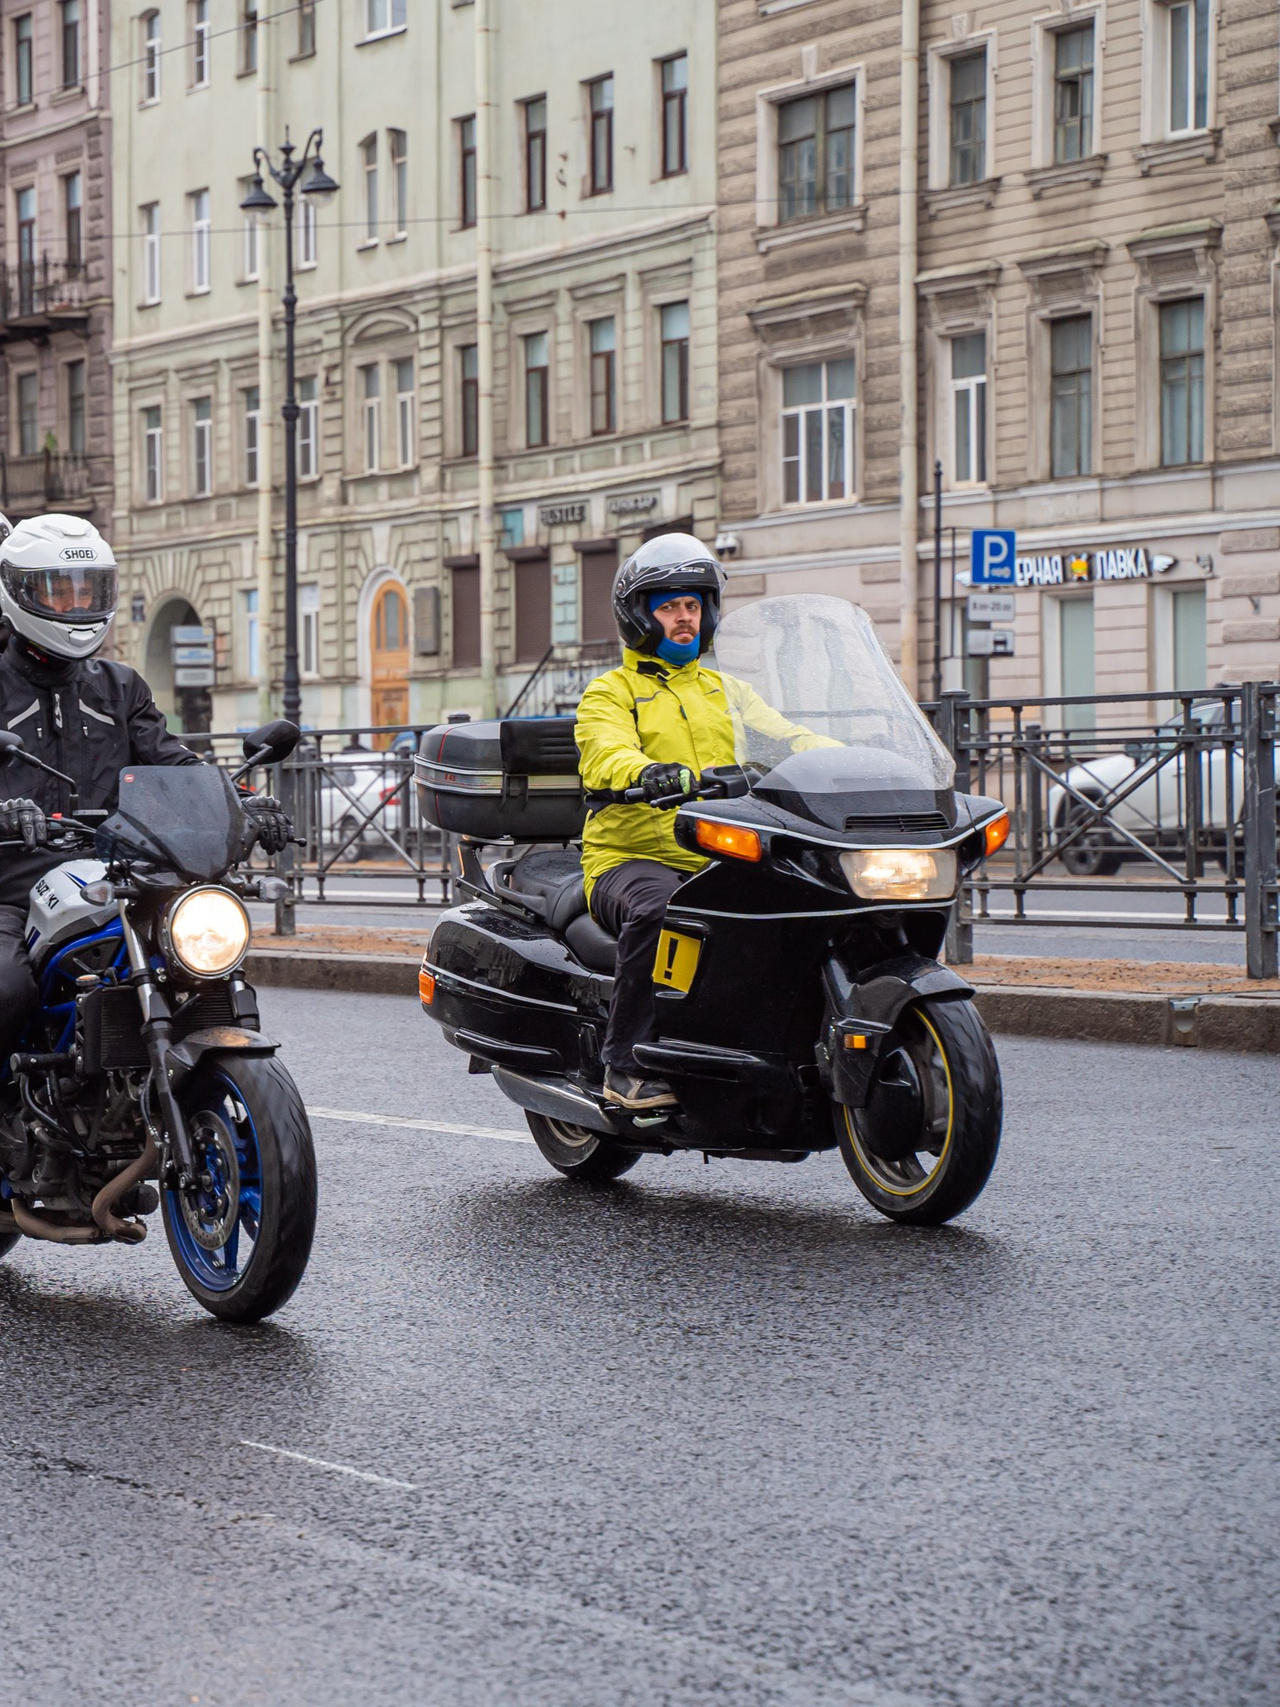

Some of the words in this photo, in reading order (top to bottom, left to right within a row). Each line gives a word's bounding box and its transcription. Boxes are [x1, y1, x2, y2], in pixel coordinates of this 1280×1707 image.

[64, 549, 94, 560] SHOEI
[1015, 554, 1064, 587] ЕРНАЯ
[1095, 547, 1149, 581] ЛАВКА
[35, 879, 60, 910] SUZKI
